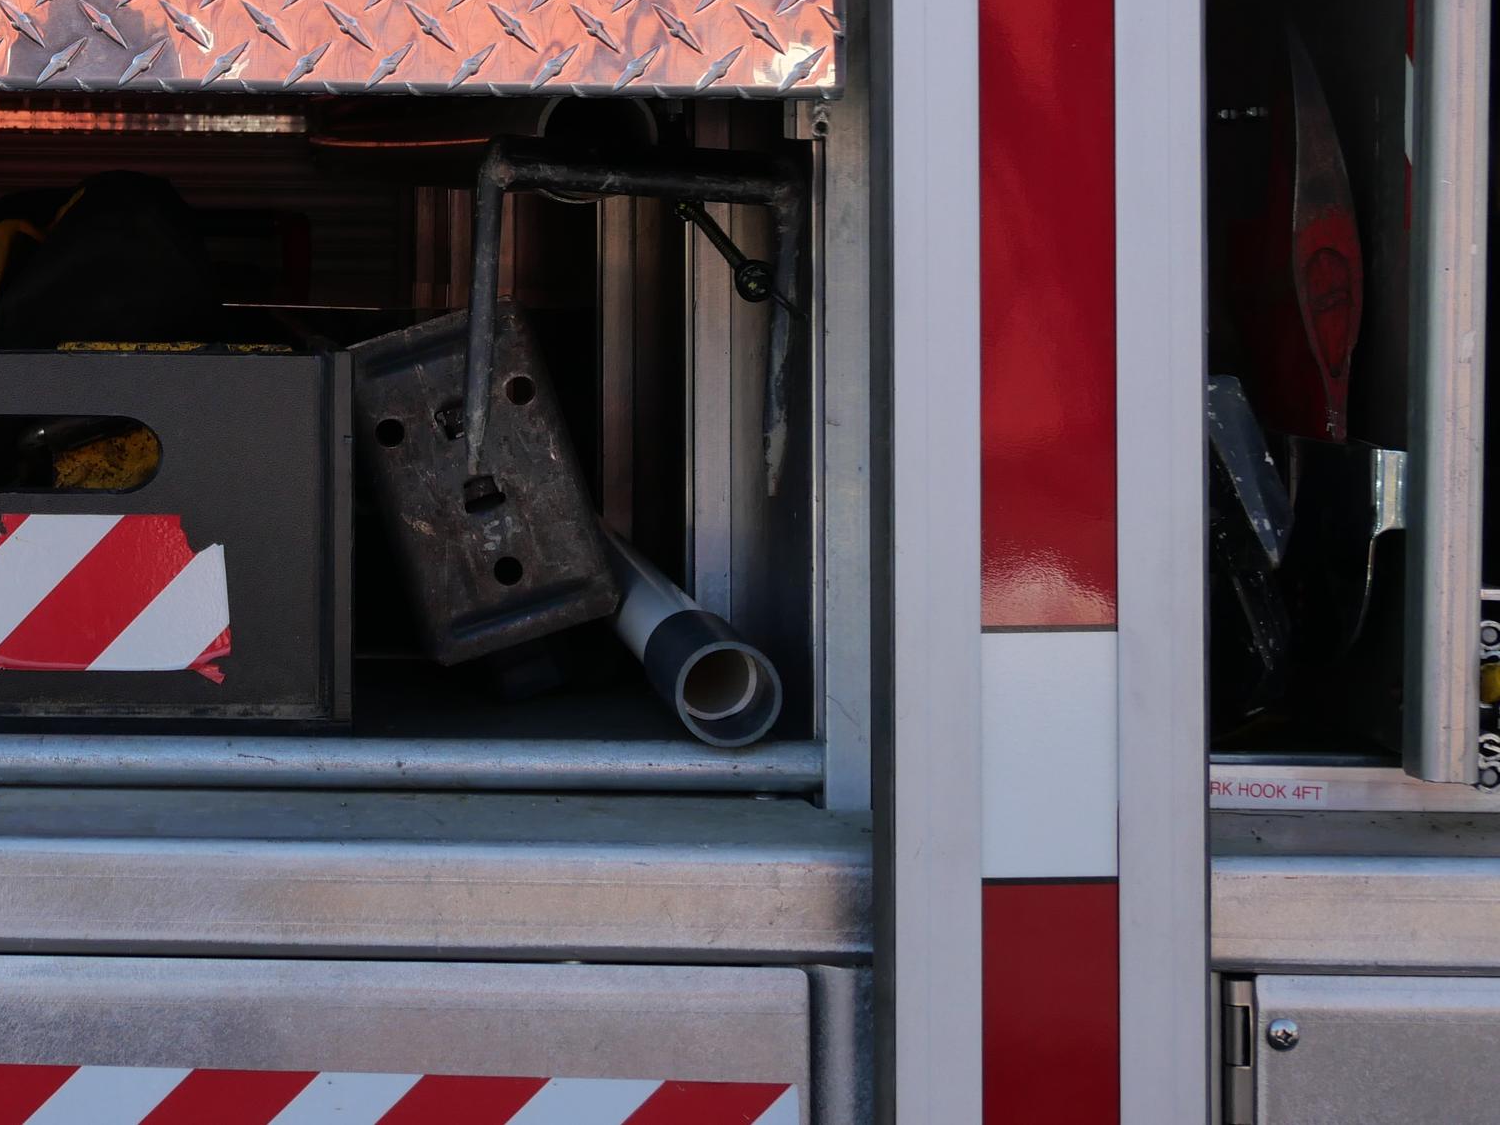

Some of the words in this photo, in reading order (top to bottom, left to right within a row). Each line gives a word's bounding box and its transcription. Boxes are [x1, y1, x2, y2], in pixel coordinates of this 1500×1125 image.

[1210, 781, 1233, 796] RK
[1238, 783, 1287, 799] HOOK
[1292, 786, 1323, 801] 4FT
